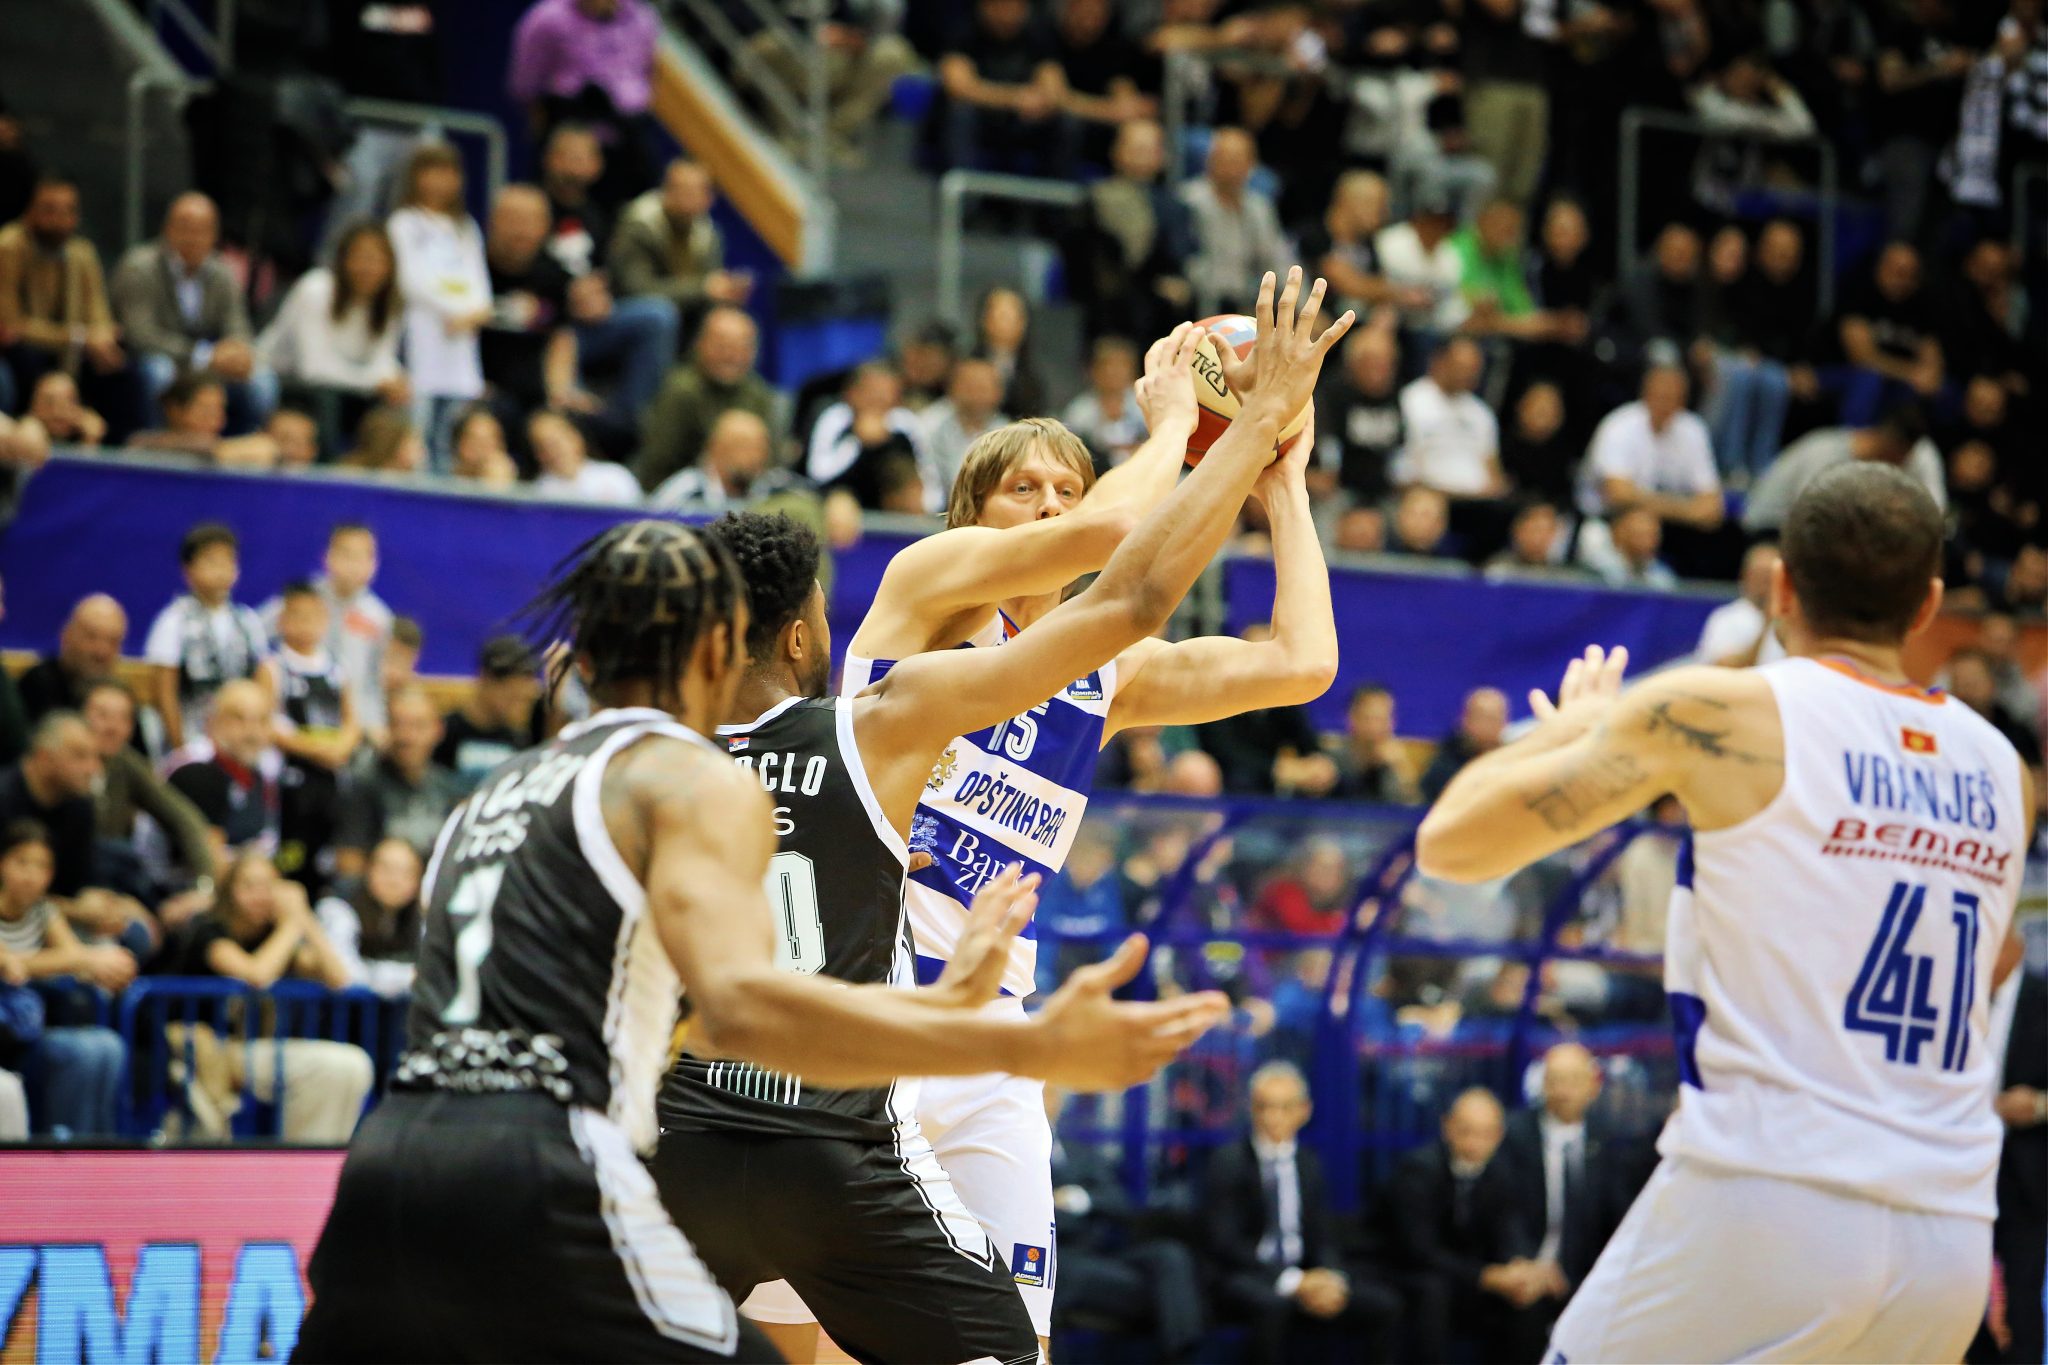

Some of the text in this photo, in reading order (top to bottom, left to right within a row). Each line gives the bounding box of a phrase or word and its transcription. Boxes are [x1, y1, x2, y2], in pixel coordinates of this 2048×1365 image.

[954, 771, 1041, 837] OPŠTINA
[1843, 750, 1997, 832] VRANJEŠ
[1844, 880, 1980, 1073] 41
